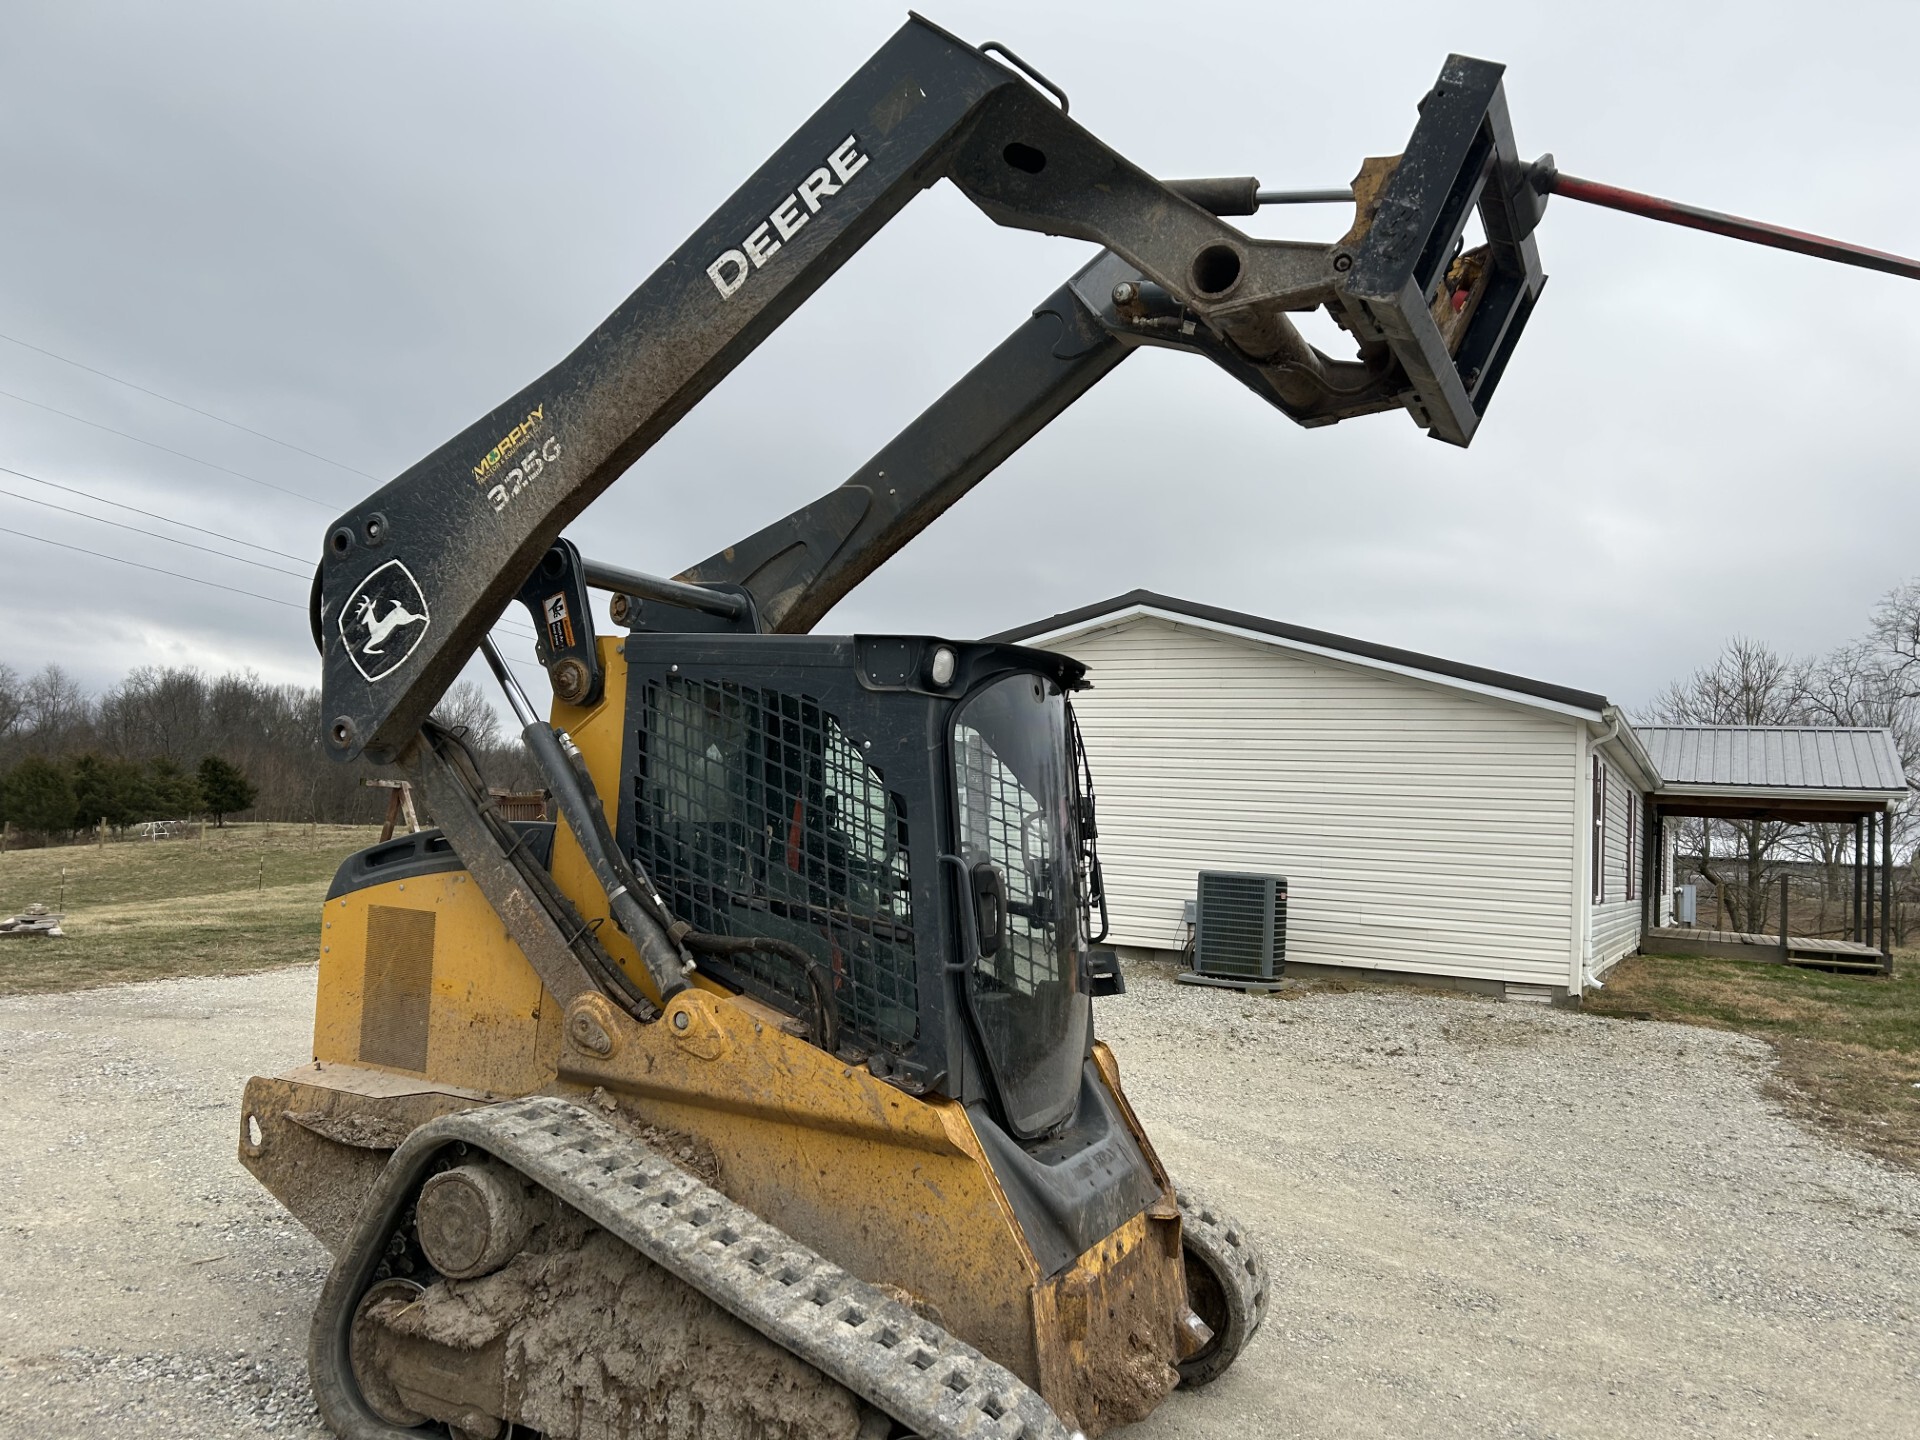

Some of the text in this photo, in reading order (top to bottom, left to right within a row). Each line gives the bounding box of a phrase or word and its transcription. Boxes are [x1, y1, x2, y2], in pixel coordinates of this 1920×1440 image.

[706, 134, 869, 300] DEERE
[472, 403, 543, 481] MURPHY
[487, 436, 561, 513] 325G
